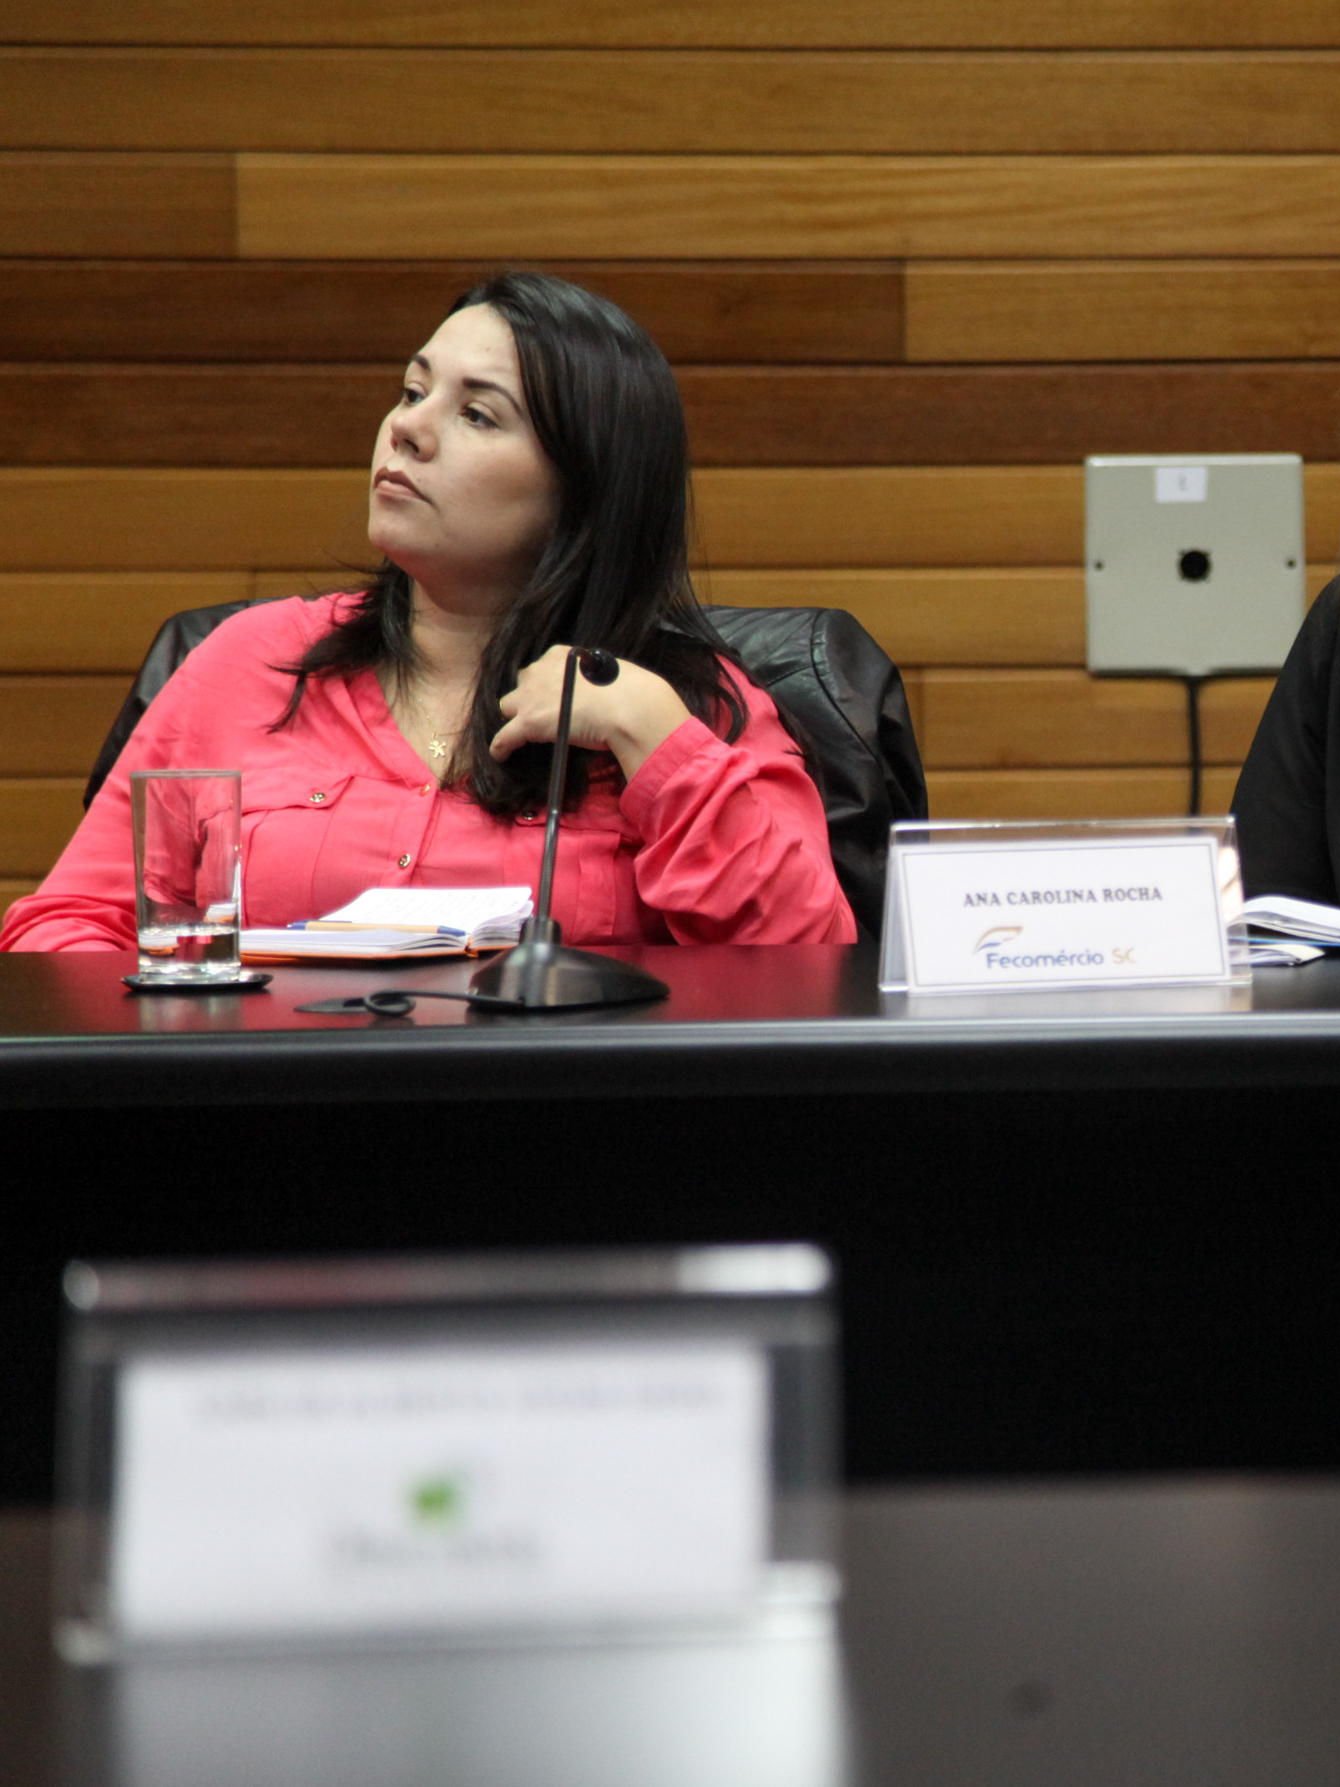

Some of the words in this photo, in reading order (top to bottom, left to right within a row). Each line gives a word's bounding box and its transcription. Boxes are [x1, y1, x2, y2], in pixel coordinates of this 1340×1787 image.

[964, 893, 1001, 907] ANA
[1006, 890, 1097, 905] CAROLINA
[1103, 887, 1163, 902] ROCHA
[986, 950, 1104, 969] Fecomércio
[1112, 948, 1136, 965] SC
